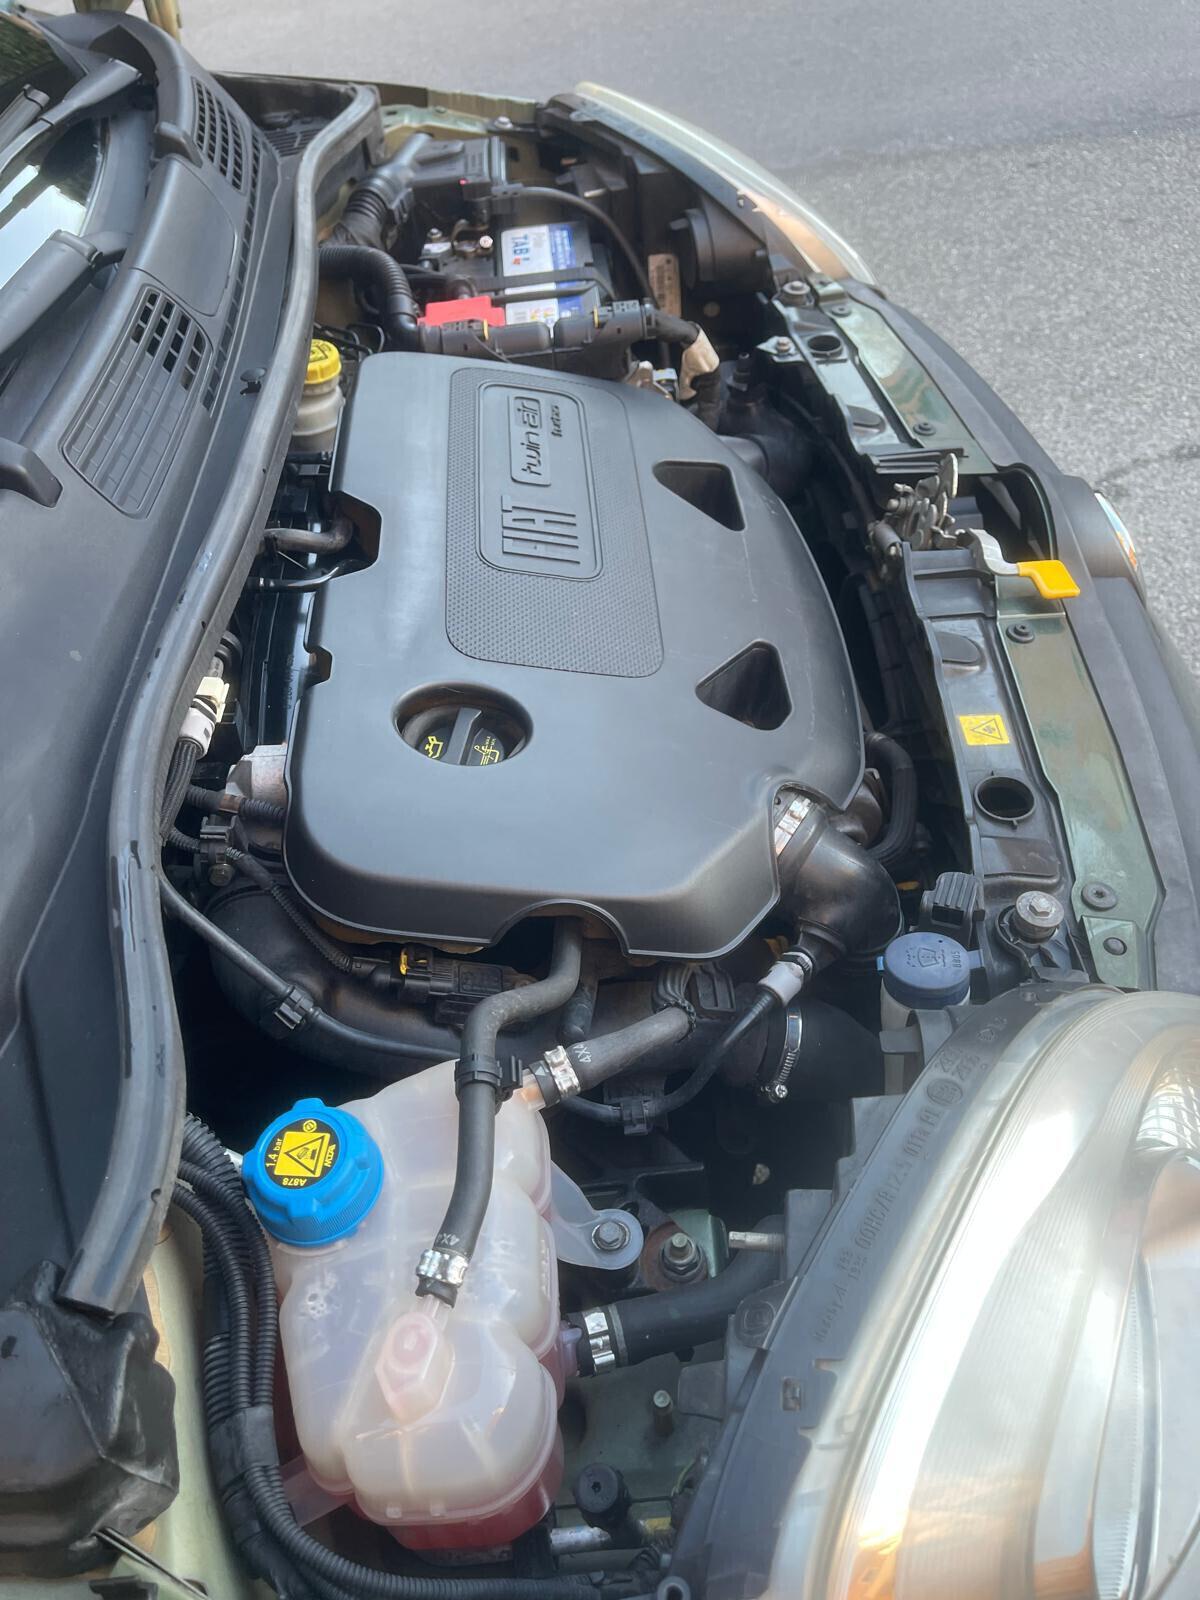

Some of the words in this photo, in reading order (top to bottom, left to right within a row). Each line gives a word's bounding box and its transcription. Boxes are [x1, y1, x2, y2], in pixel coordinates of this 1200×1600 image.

[501, 494, 581, 566] FIAT
[265, 1152, 279, 1168] 1.4
[272, 1138, 283, 1151] bar
[282, 1177, 307, 1187] A878
